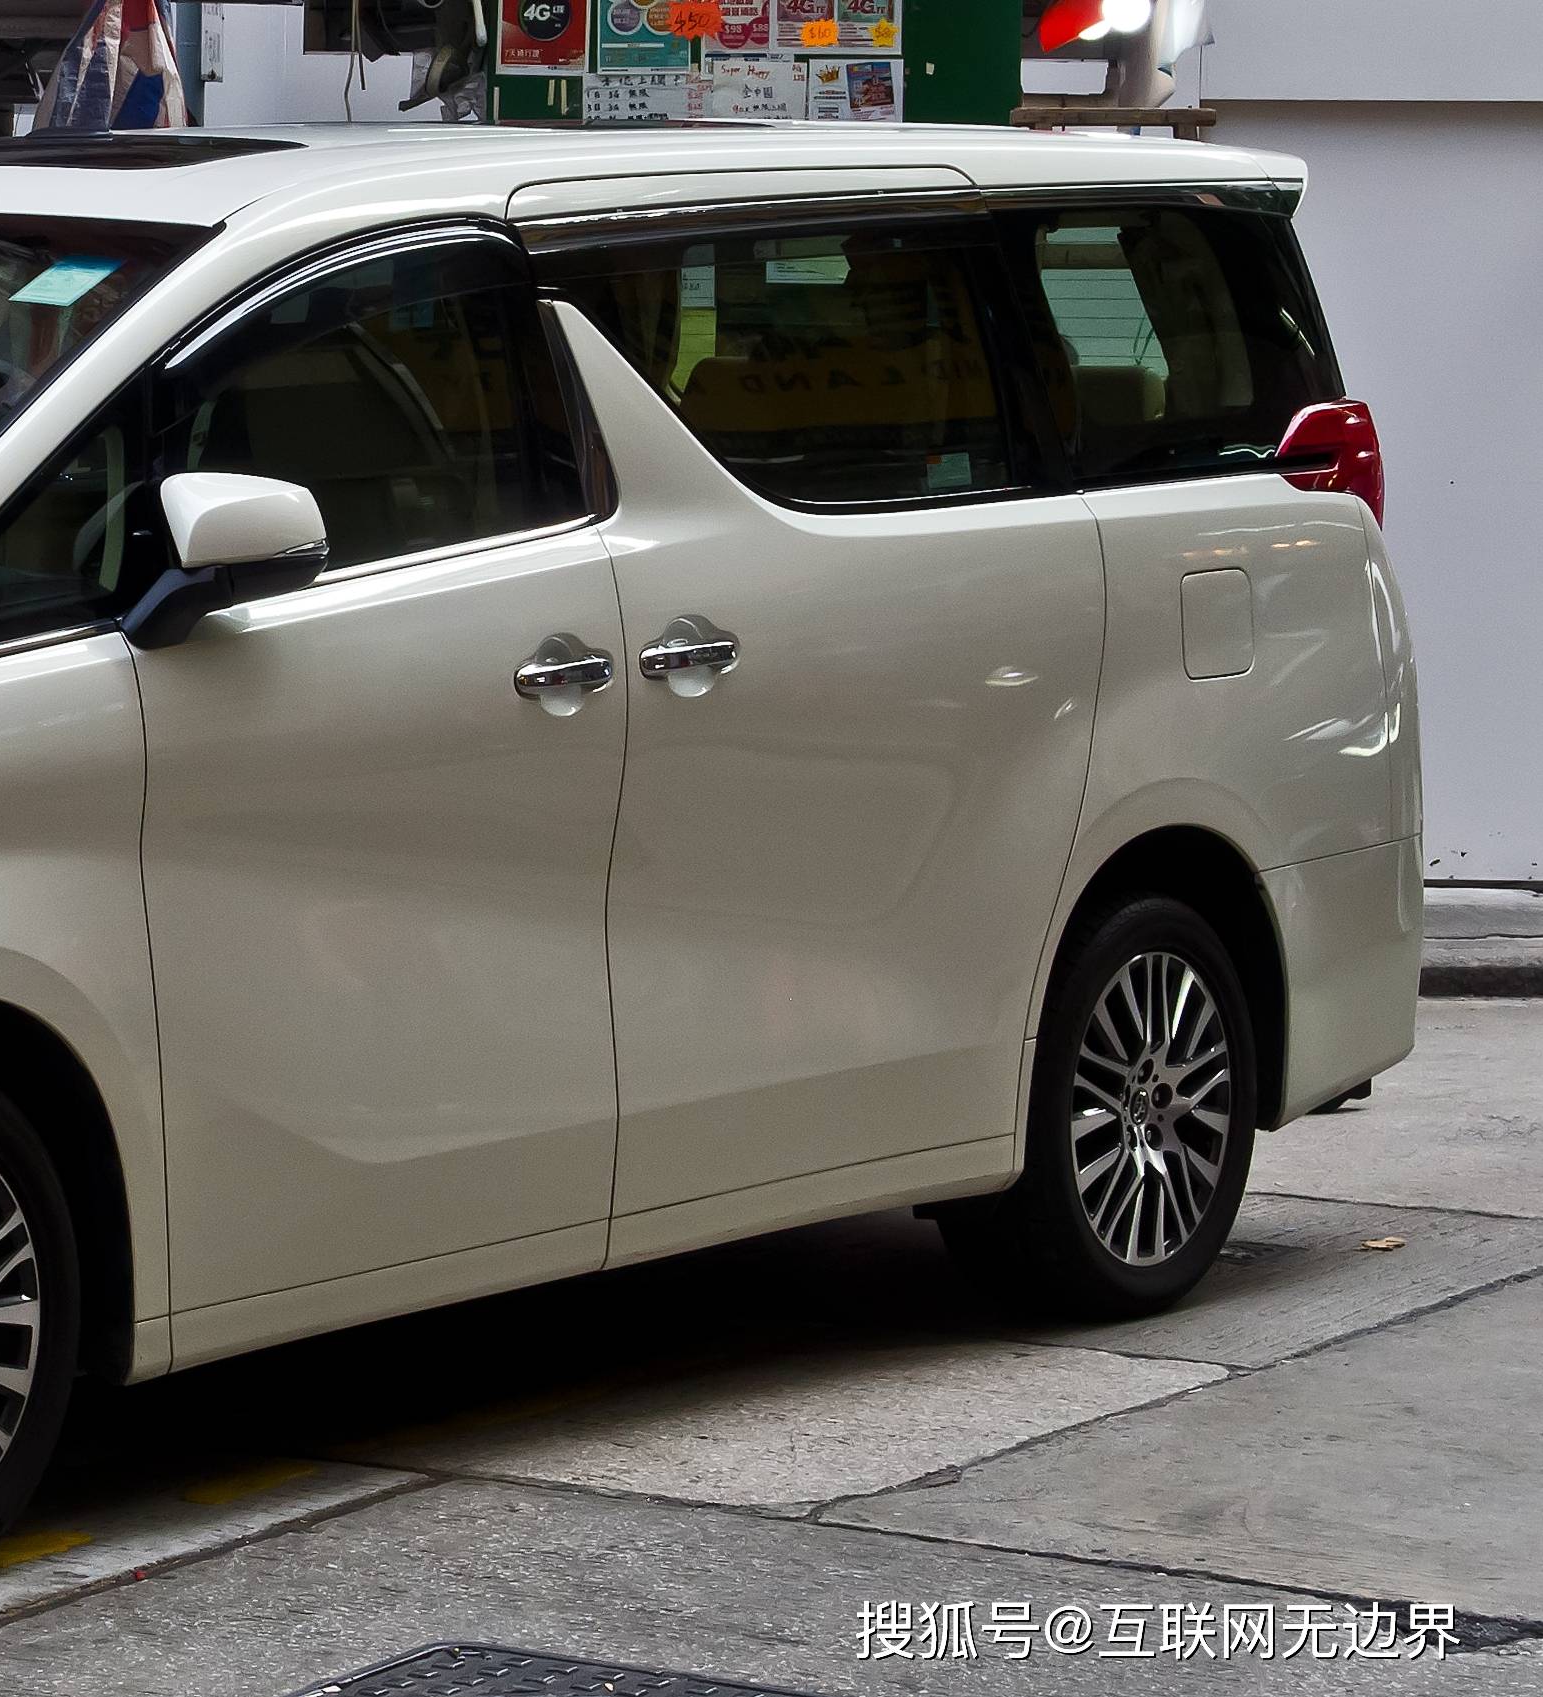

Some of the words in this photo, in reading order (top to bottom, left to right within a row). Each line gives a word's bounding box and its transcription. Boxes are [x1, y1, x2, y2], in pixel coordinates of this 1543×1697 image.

[523, 3, 551, 21] 4G
[552, 5, 565, 14] LTE
[787, 0, 815, 14] 4G
[847, 0, 875, 14] 4G
[720, 64, 741, 76] Super
